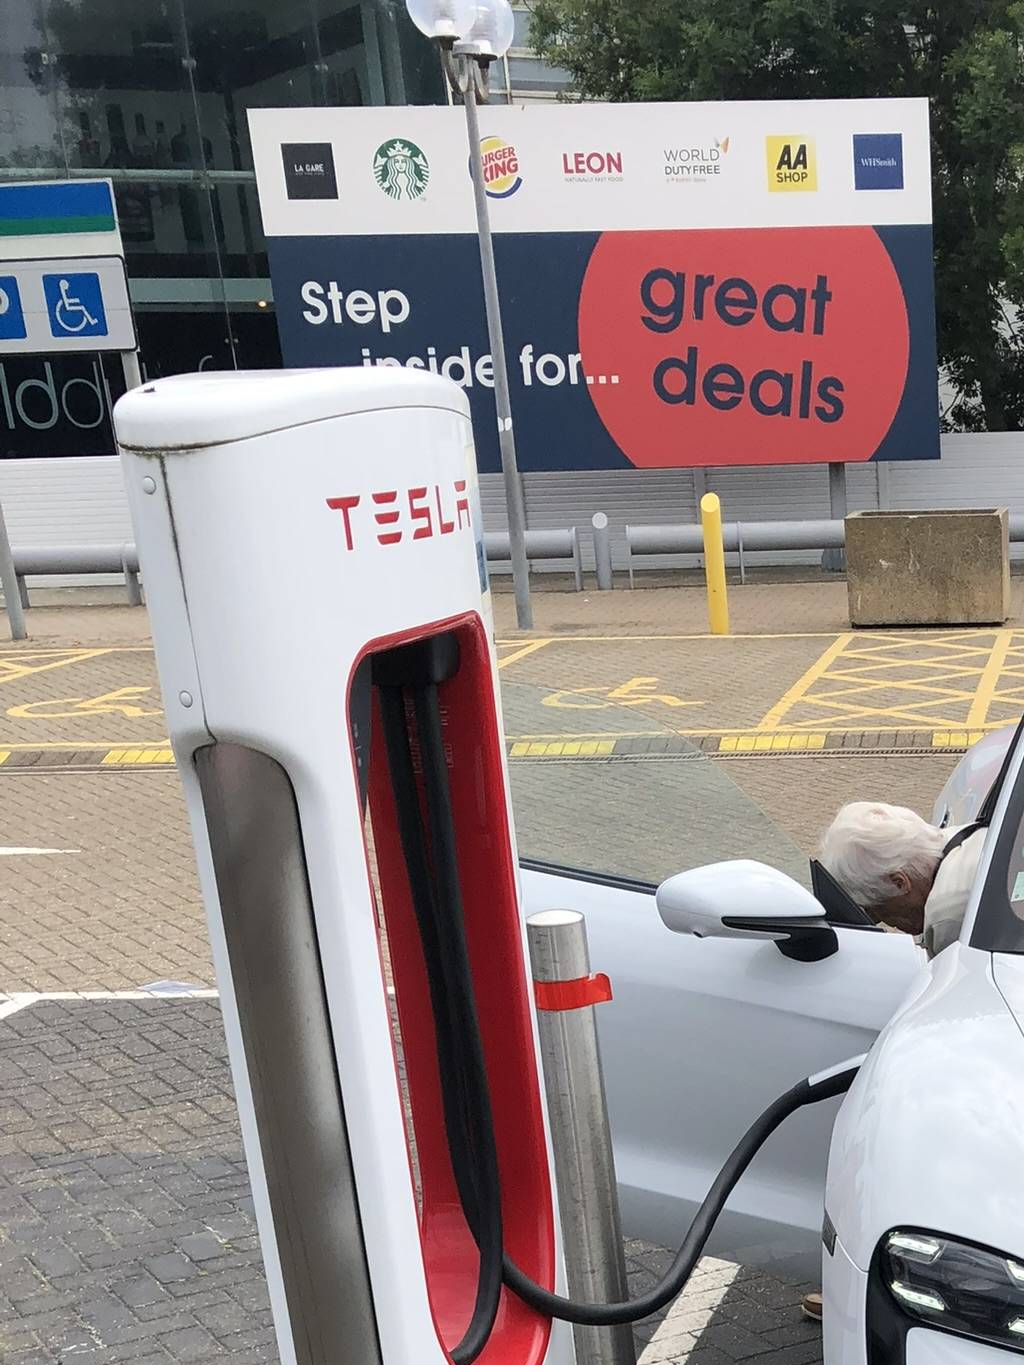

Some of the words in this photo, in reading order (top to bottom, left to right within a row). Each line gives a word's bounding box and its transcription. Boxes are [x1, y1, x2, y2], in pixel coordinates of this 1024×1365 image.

[482, 147, 516, 167] URGER
[563, 152, 624, 174] LEON
[663, 148, 720, 162] WORLD
[776, 144, 808, 170] AA
[861, 157, 897, 167] WHSmith
[294, 163, 304, 172] LA
[305, 163, 325, 172] GARE
[776, 172, 808, 183] SHOP
[301, 281, 410, 333] Step
[640, 267, 833, 335] great
[653, 346, 845, 424] deals
[326, 479, 471, 551] TESLA
